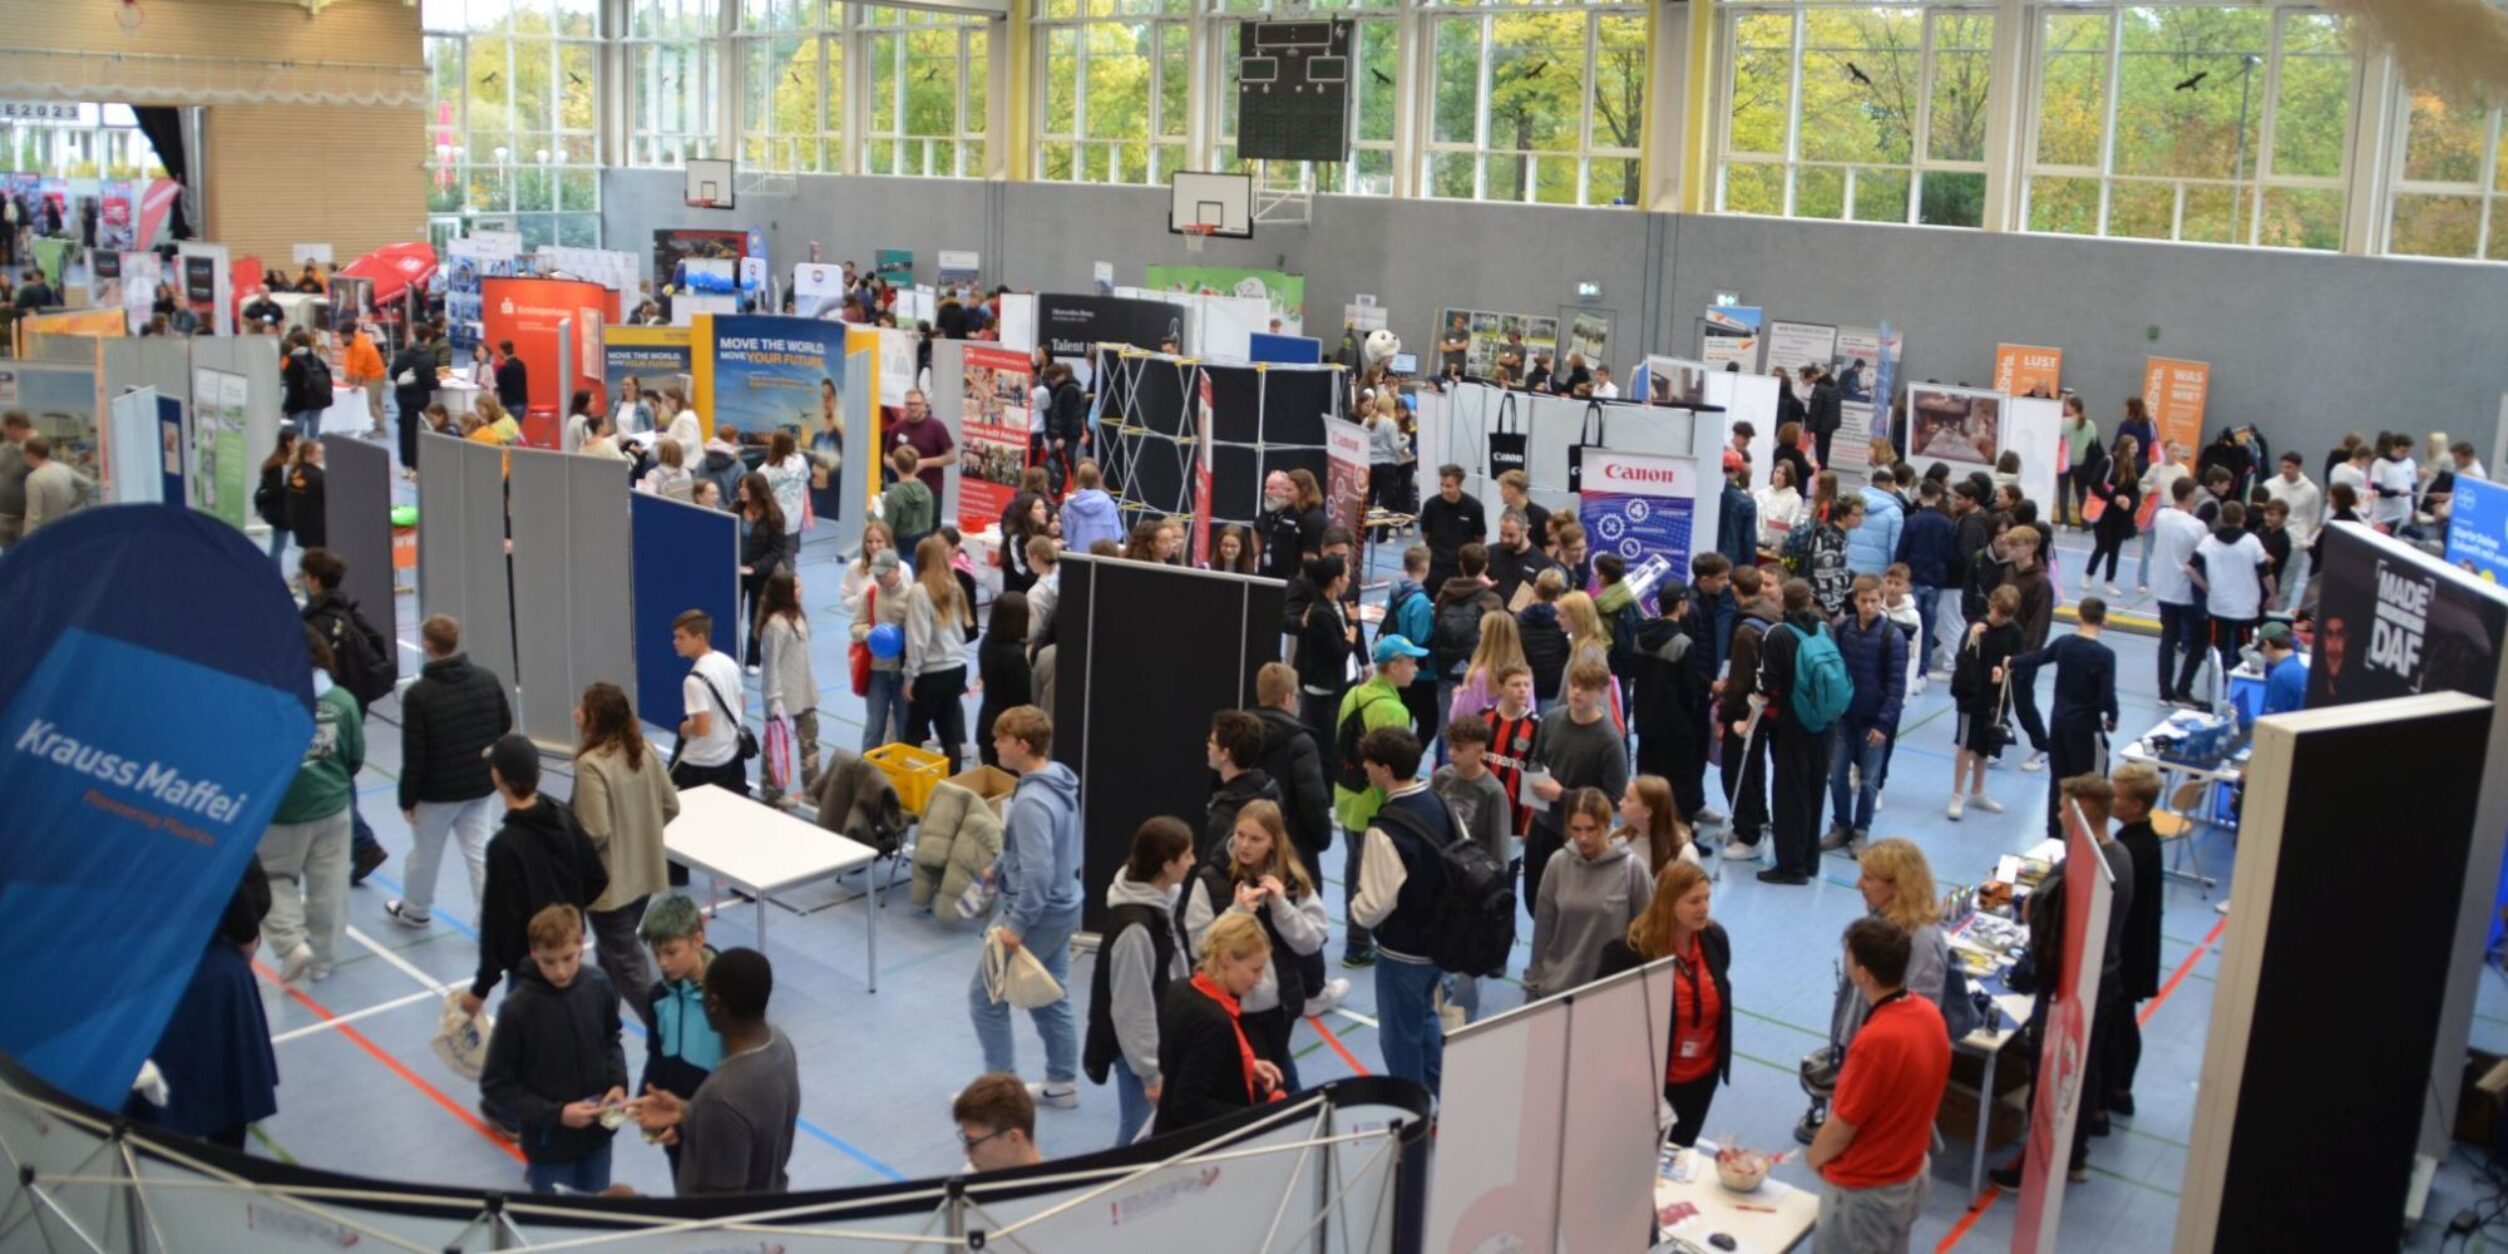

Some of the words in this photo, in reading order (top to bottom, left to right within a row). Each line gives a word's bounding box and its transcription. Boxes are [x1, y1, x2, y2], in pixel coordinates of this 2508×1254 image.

[720, 338, 758, 350] MOVE
[761, 339, 785, 351] THE
[1051, 338, 1085, 352] Talent
[608, 351, 631, 360] MOVE
[720, 351, 746, 360] MOVE
[746, 352, 781, 364] YOUR
[2024, 355, 2056, 367] LUST
[1492, 452, 1523, 463] Canon
[1604, 463, 1674, 483] Canon
[2378, 571, 2430, 616] MADE
[2370, 618, 2423, 678] DAF
